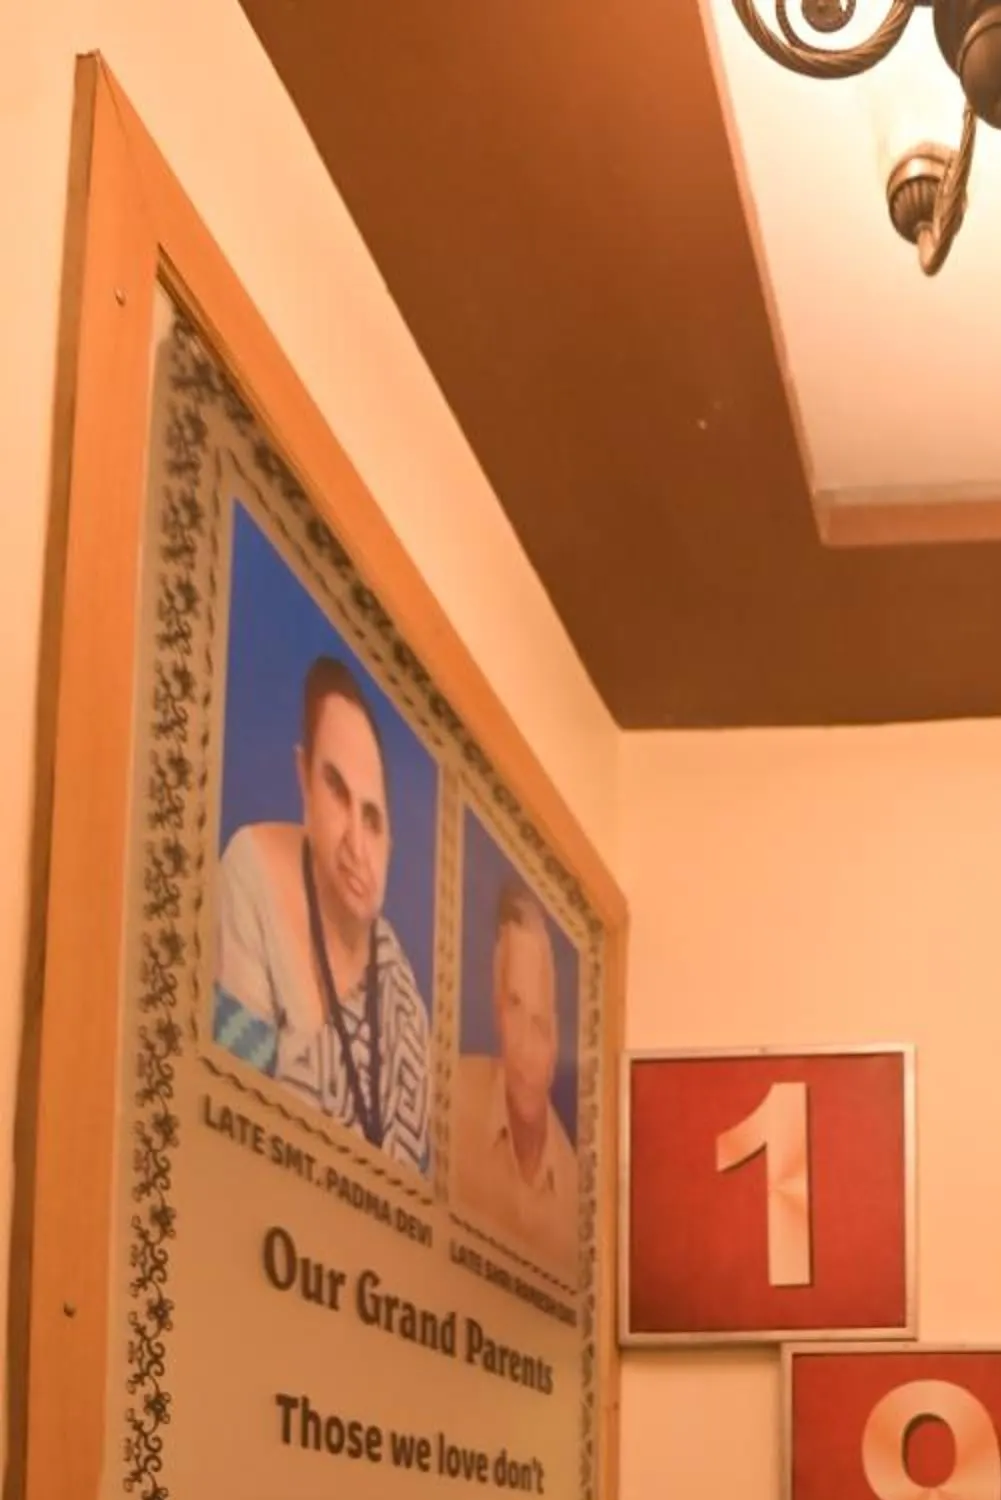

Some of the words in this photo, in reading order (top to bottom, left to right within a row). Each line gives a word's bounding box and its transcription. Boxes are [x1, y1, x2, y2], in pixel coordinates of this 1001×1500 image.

[203, 1094, 265, 1155] LATE
[325, 1166, 391, 1228] PADMA
[395, 1207, 433, 1248] DEVI
[714, 1080, 811, 1287] 1
[262, 1226, 346, 1312] Our
[356, 1269, 457, 1358] Grand
[464, 1316, 554, 1395] Parents
[275, 1393, 382, 1463] Those
[390, 1430, 432, 1473] we
[438, 1432, 488, 1484] love
[493, 1449, 545, 1496] don't
